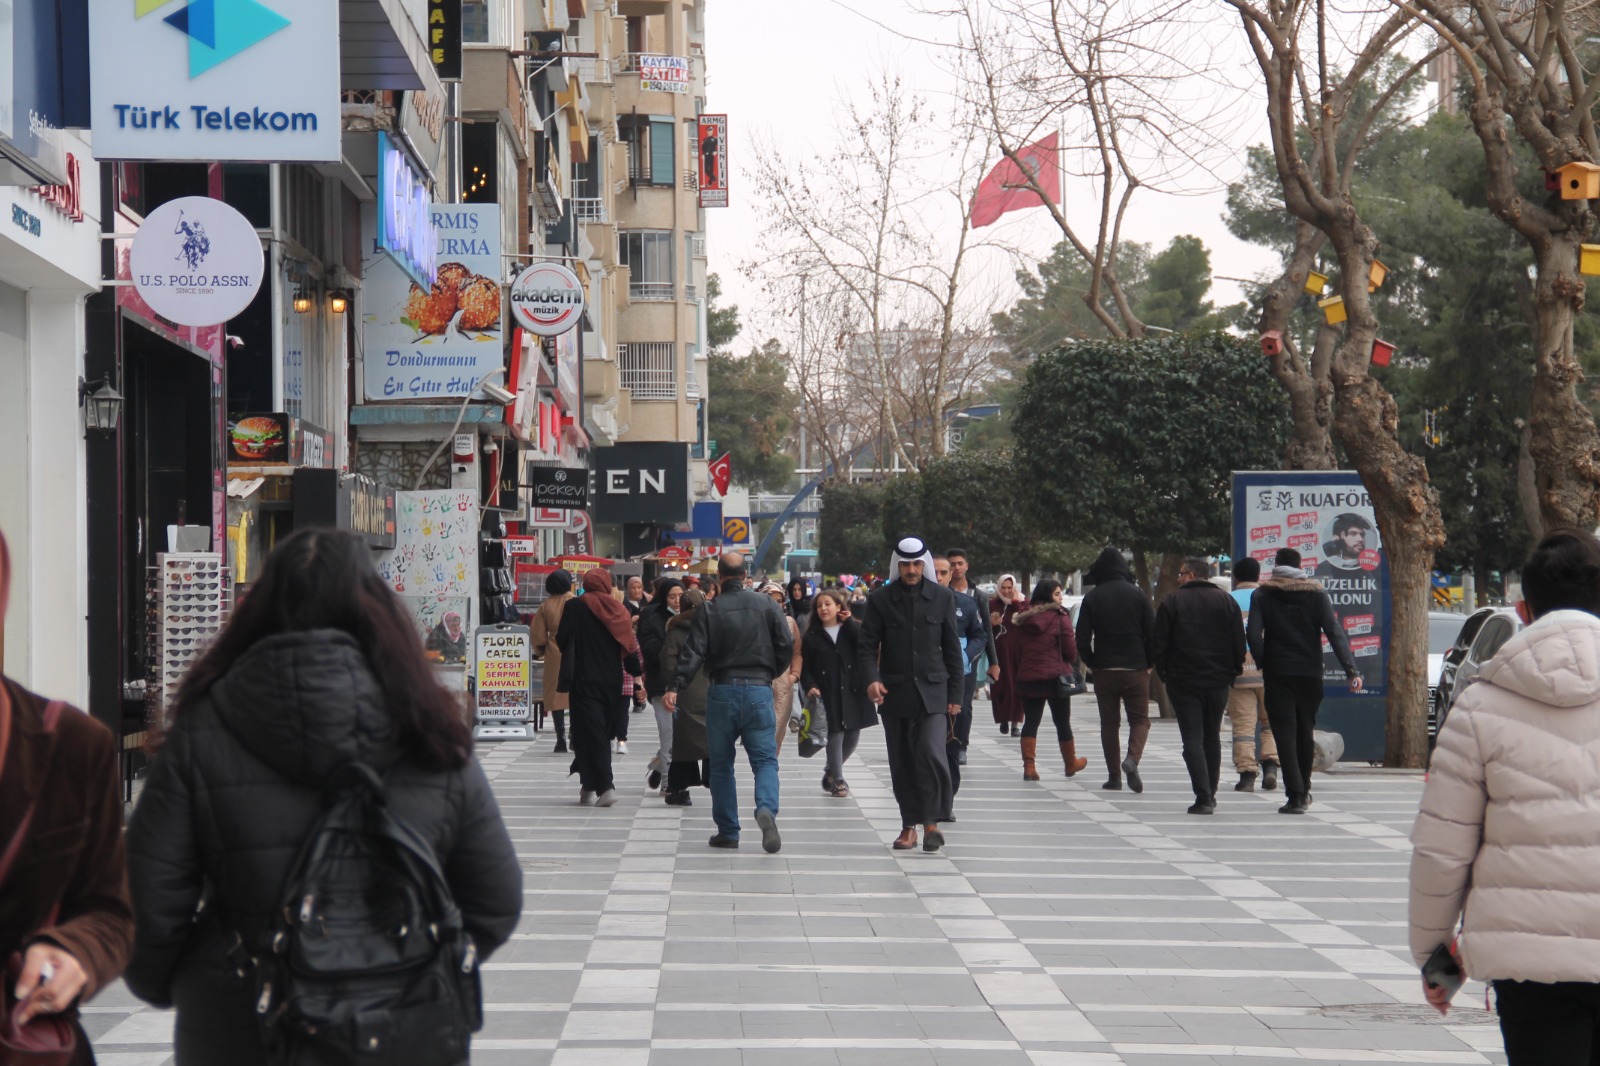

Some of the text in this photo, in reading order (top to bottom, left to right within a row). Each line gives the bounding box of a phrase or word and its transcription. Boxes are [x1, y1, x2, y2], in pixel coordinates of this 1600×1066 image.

[430, 0, 445, 63] AFE
[641, 68, 688, 81] SATILIK
[113, 104, 318, 131] Türk Telekom
[140, 275, 252, 287] U.S. POLO ASSN.
[512, 286, 581, 304] akademi
[533, 306, 559, 314] müzik
[386, 350, 477, 367] Dondurmanın
[384, 376, 404, 396] En
[409, 376, 441, 396] Çıtır
[1300, 489, 1374, 507] KUAFÖR
[1319, 576, 1377, 591] ÜZELLİK
[1327, 593, 1372, 605] LONU
[483, 635, 524, 647] FLORİA
[512, 709, 526, 717] ÇAY
